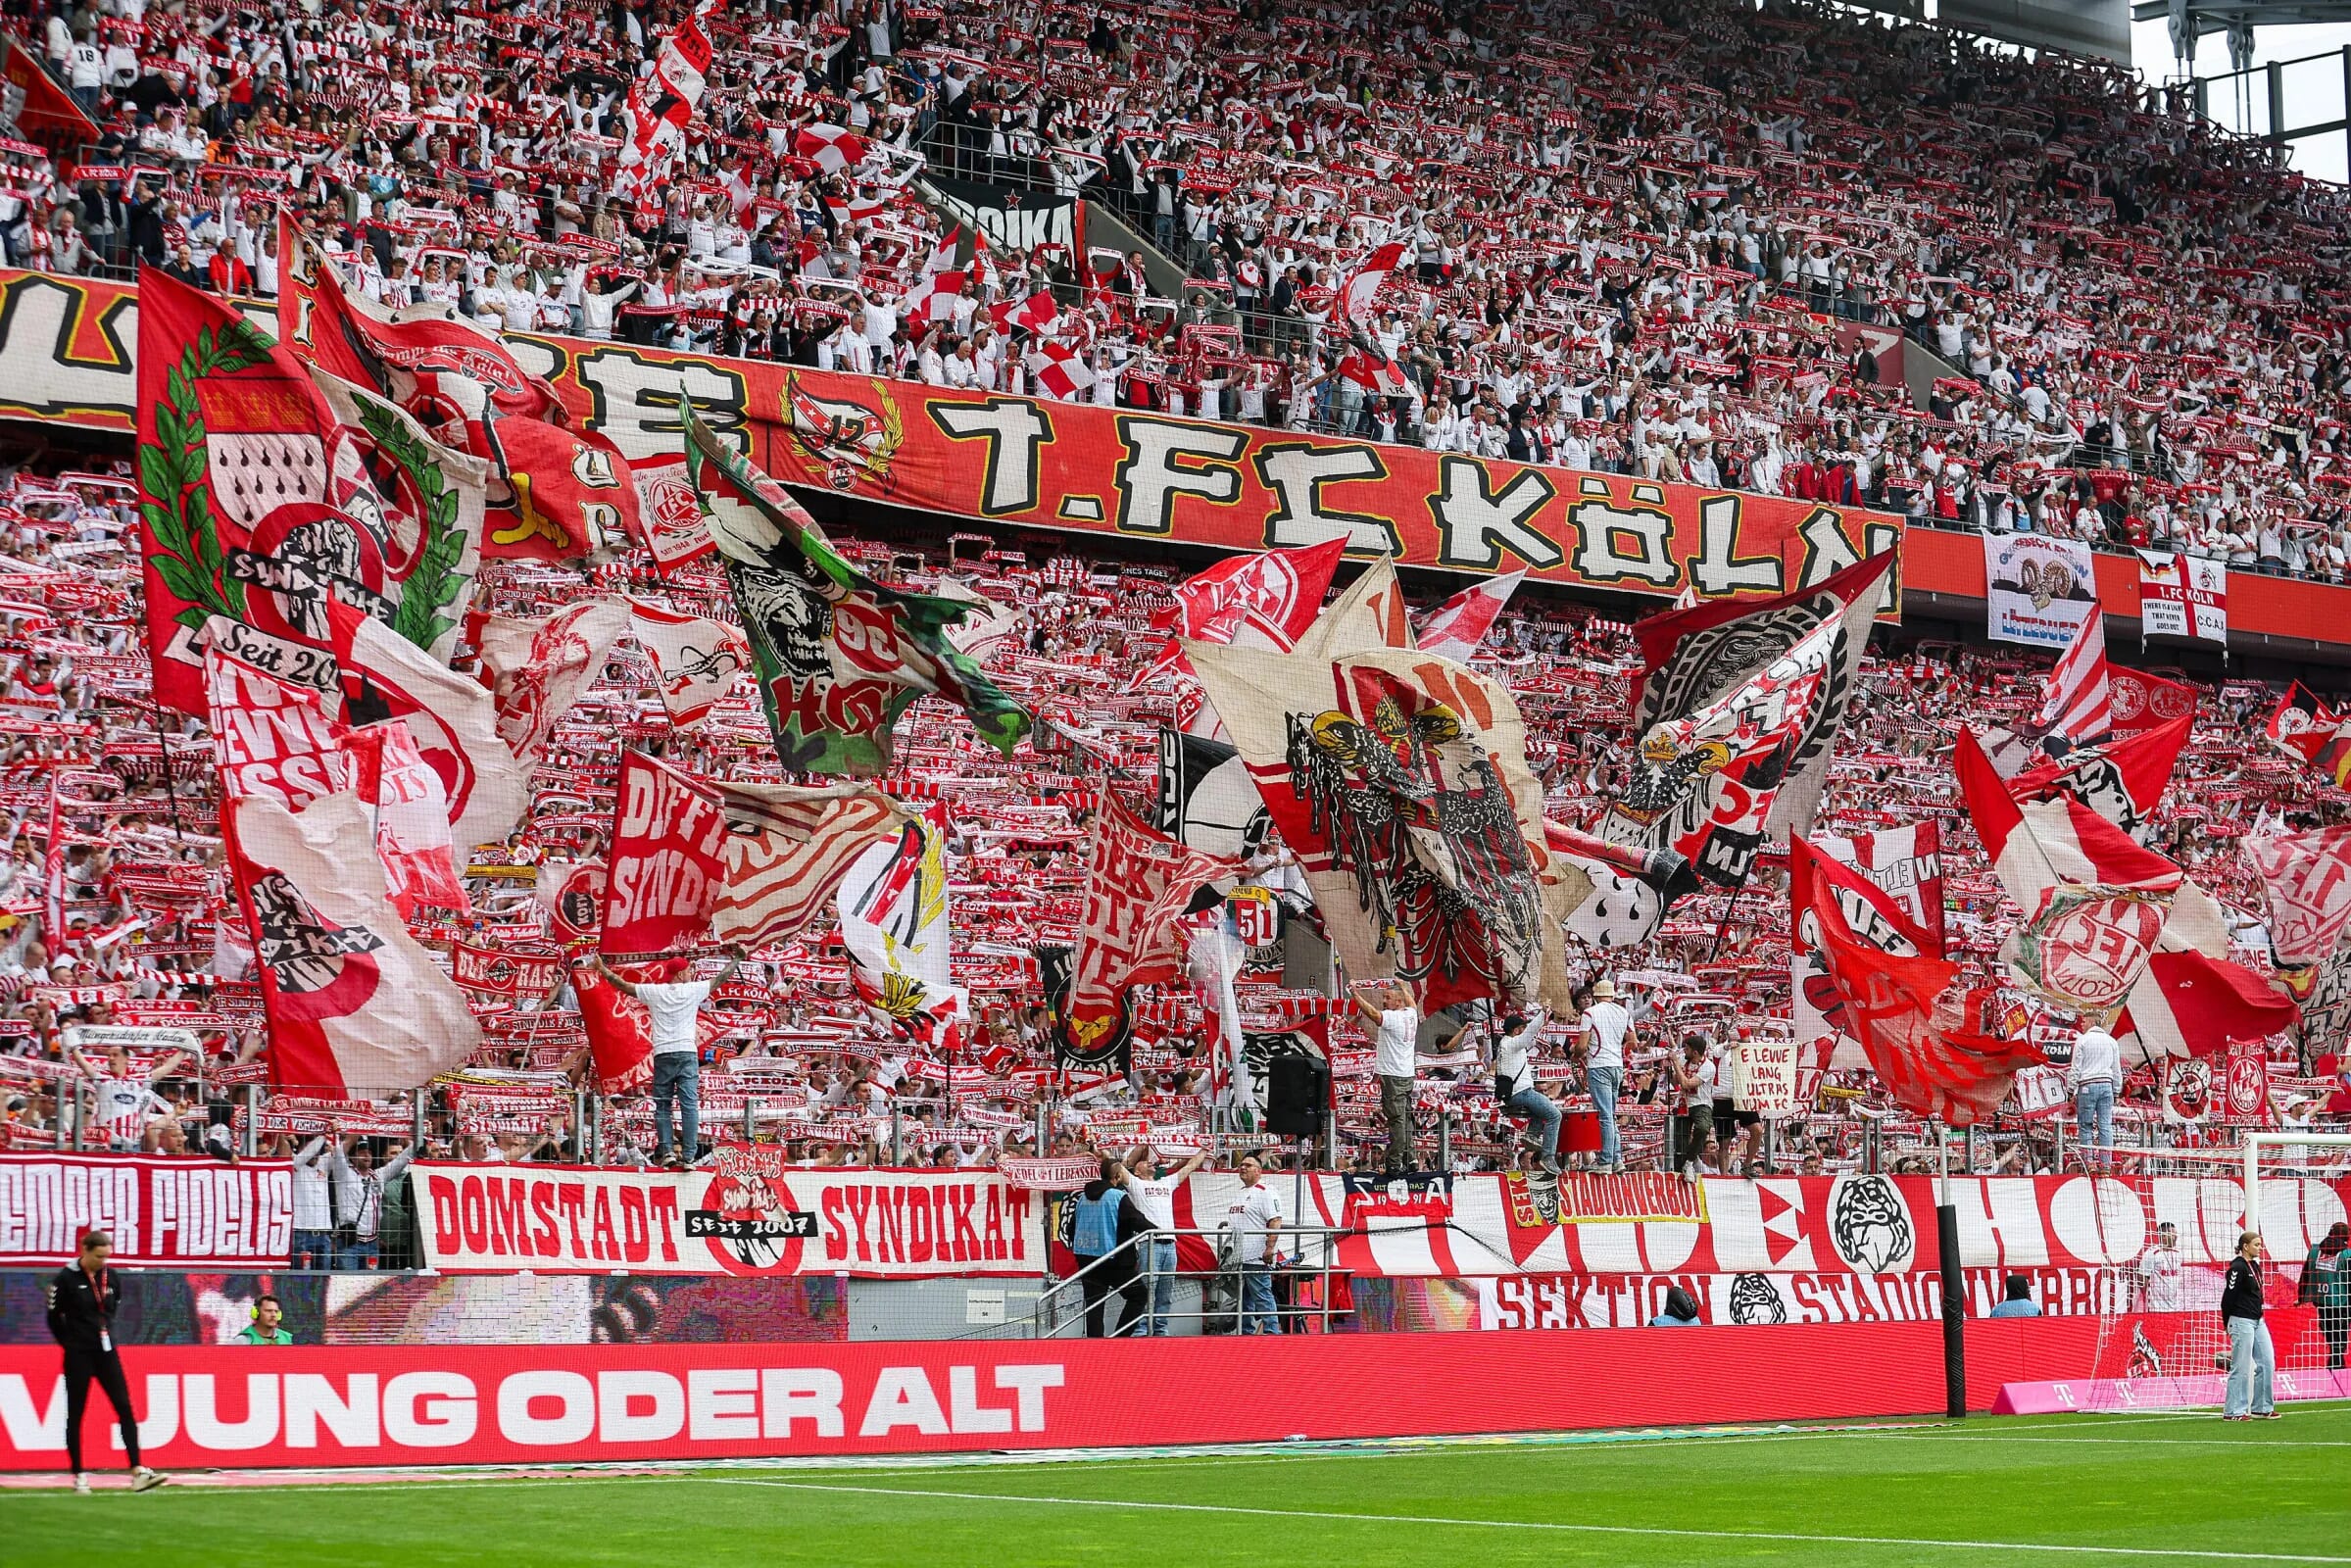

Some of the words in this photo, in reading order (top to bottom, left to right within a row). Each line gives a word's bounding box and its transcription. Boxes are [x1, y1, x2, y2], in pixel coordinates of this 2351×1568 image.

[78, 50, 94, 63] 18
[827, 416, 865, 452] 12
[926, 396, 1401, 559] 1.FC
[1426, 457, 1898, 623] KÖLN
[2186, 588, 2215, 606] KÖLN
[221, 624, 282, 672] Seit
[92, 658, 115, 666] SIND
[1033, 773, 1073, 788] CHAOTIX
[1001, 858, 1024, 869] KÖLN
[1239, 908, 1273, 945] 51
[2041, 1042, 2072, 1055] KÖLN
[1740, 1049, 1749, 1063] E
[1751, 1066, 1782, 1080] LANG
[1746, 1083, 1788, 1097] ULTRAS
[1742, 1099, 1770, 1111] VUM
[1775, 1099, 1788, 1110] FC
[269, 1116, 288, 1129] DER
[1117, 1134, 1197, 1146] SYNDIKAT
[1377, 1195, 1388, 1205] 19
[1509, 1175, 1536, 1226] SEK
[1558, 1174, 1702, 1220] STADIONVERBOT
[151, 1167, 293, 1256] FIDELIS
[429, 1175, 679, 1263] DOMSTADT
[821, 1184, 1030, 1263] SYNDIKAT
[691, 1216, 743, 1235] SEIT
[752, 1216, 809, 1235] 2007
[2317, 1283, 2329, 1294] 10
[1497, 1276, 1713, 1331] SEKTION
[111, 1371, 478, 1451] JUNG
[497, 1367, 845, 1446] ODER
[858, 1364, 1065, 1437] ALT
